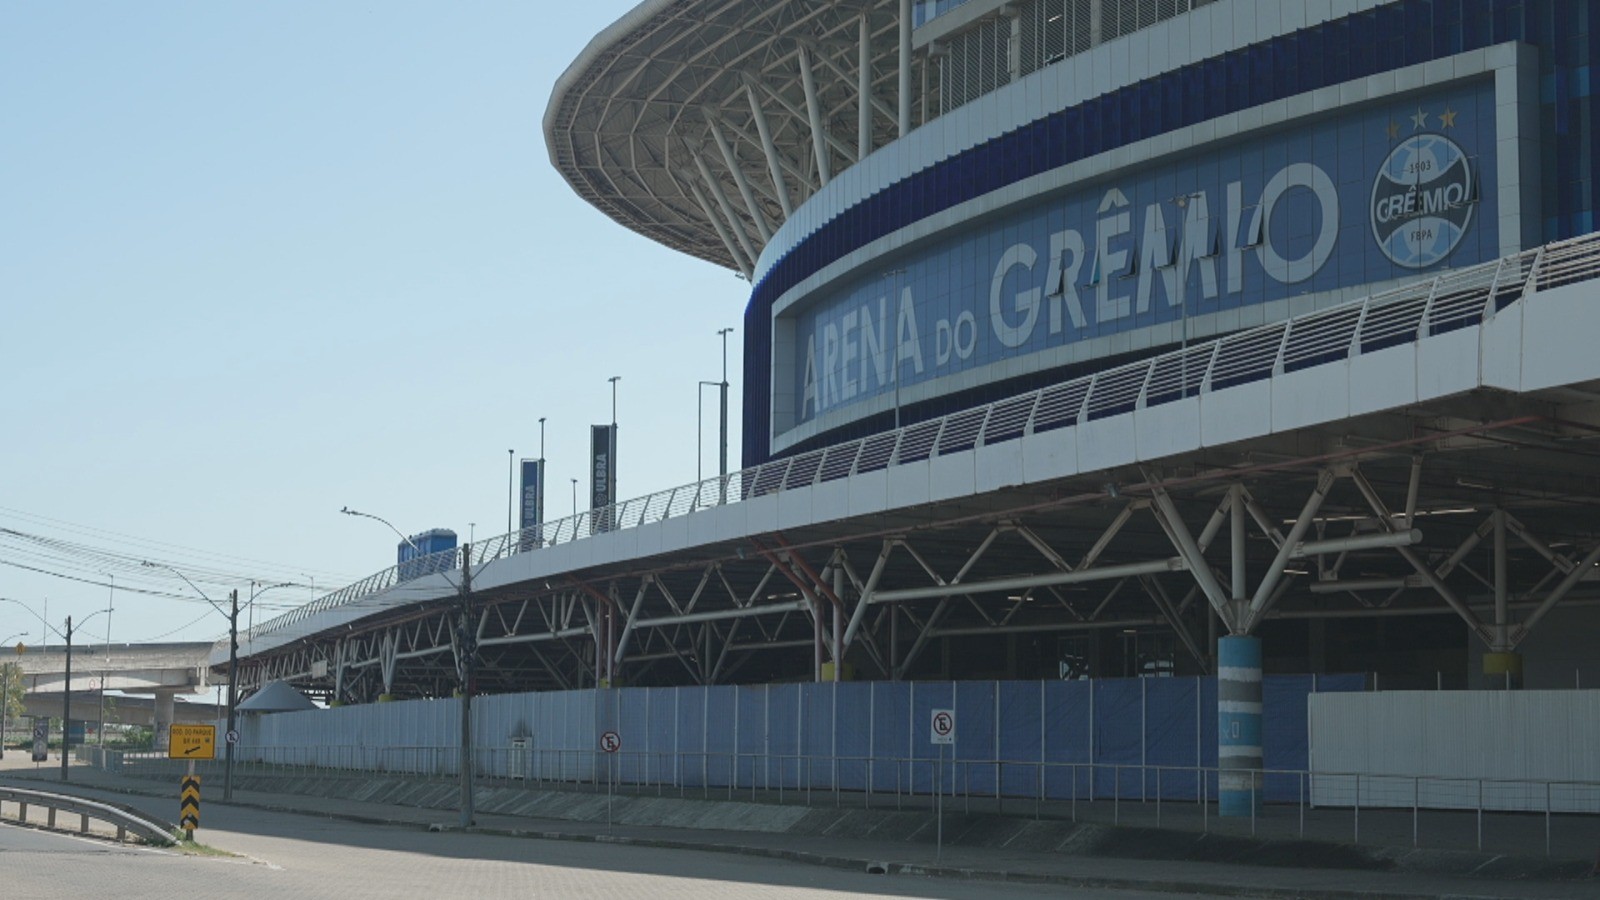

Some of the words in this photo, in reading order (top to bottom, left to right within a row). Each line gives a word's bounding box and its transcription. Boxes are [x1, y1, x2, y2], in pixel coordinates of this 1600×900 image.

[1410, 160, 1431, 173] 1903
[1410, 229, 1432, 242] FBPA
[802, 285, 924, 420] ARENA
[936, 310, 977, 367] DO
[989, 162, 1340, 348] GRÊMIO
[596, 453, 607, 493] ULBRA
[524, 484, 536, 520] ULBRA
